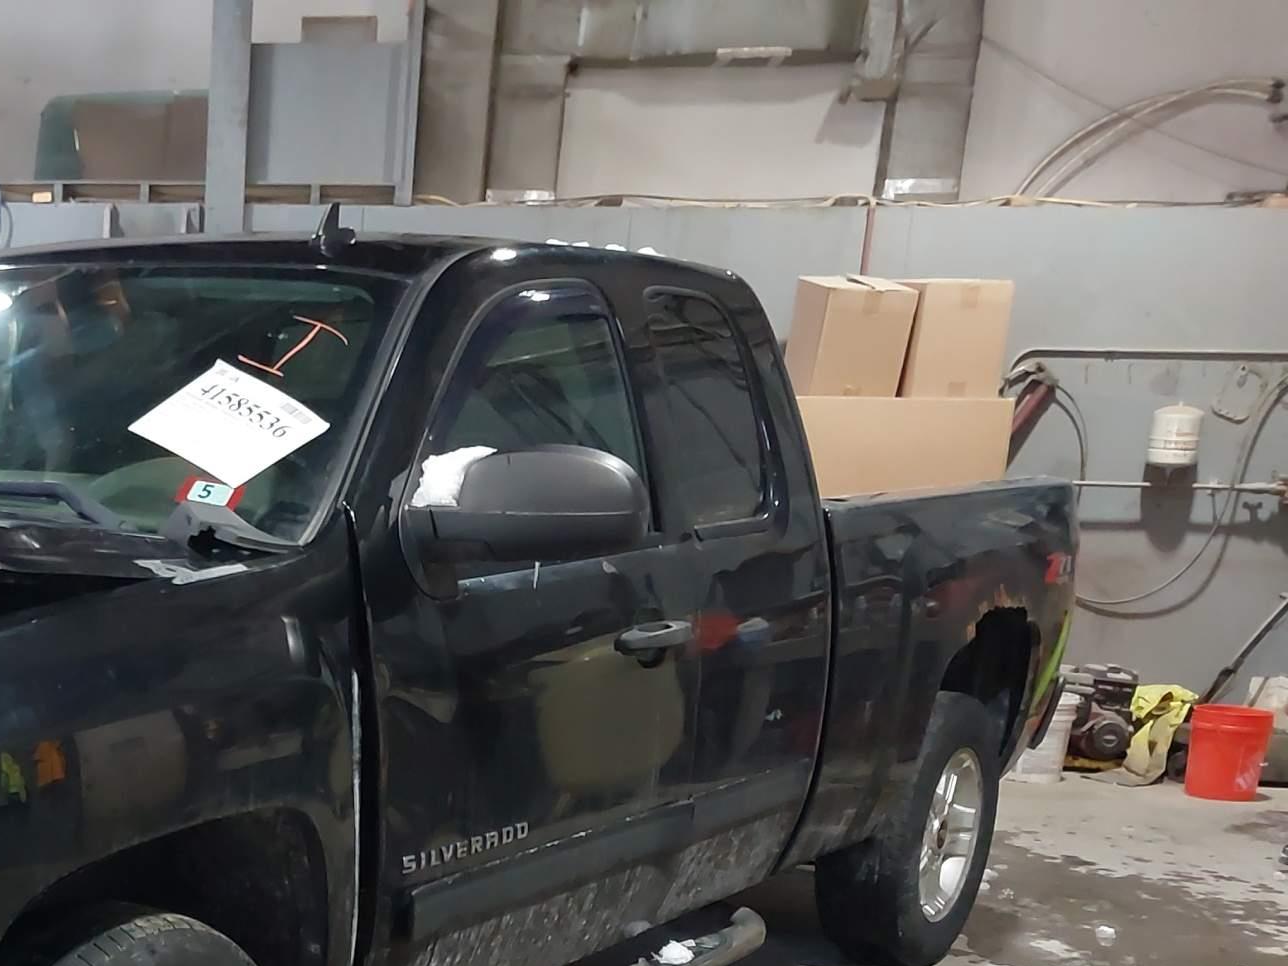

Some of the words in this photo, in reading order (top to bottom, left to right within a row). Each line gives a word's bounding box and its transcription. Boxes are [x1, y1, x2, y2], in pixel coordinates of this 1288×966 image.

[201, 384, 292, 438] 41585536
[197, 483, 215, 499] 5
[401, 821, 529, 875] SILVERADO
